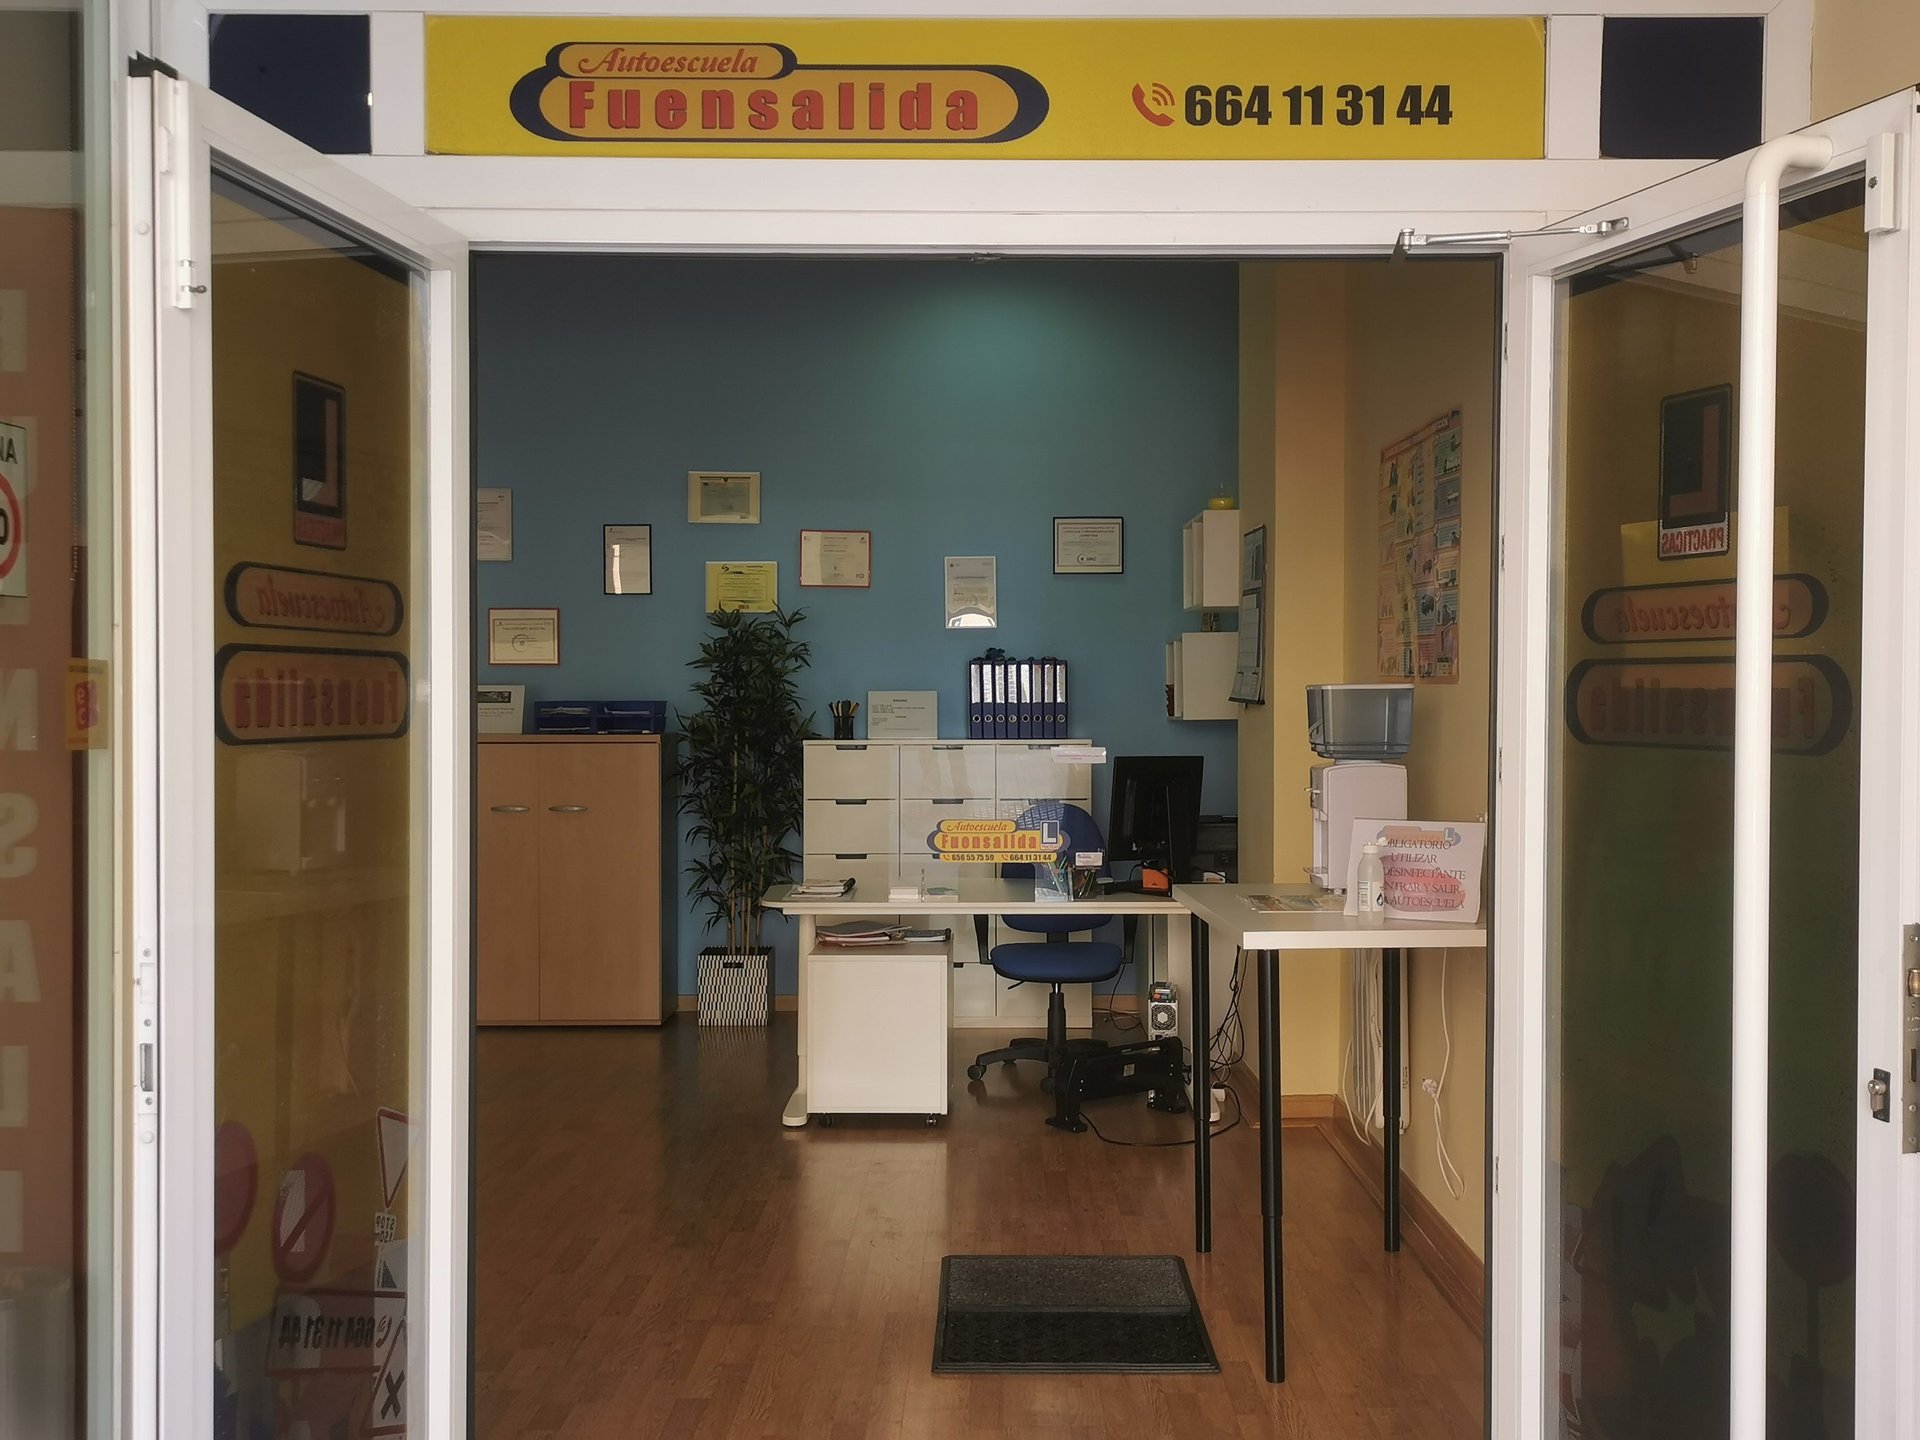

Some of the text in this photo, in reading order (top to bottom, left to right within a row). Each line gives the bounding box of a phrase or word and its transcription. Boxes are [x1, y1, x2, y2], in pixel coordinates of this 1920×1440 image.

[578, 47, 758, 74] Autoescuela
[568, 80, 979, 131] Fuensalida
[1184, 84, 1454, 127] 664 11 31 44
[946, 821, 1008, 832] Autoescuela
[941, 833, 1037, 849] Fuensalida
[1390, 852, 1438, 864] UTILIZAR
[1383, 881, 1462, 895] NTRAR Y SALIR
